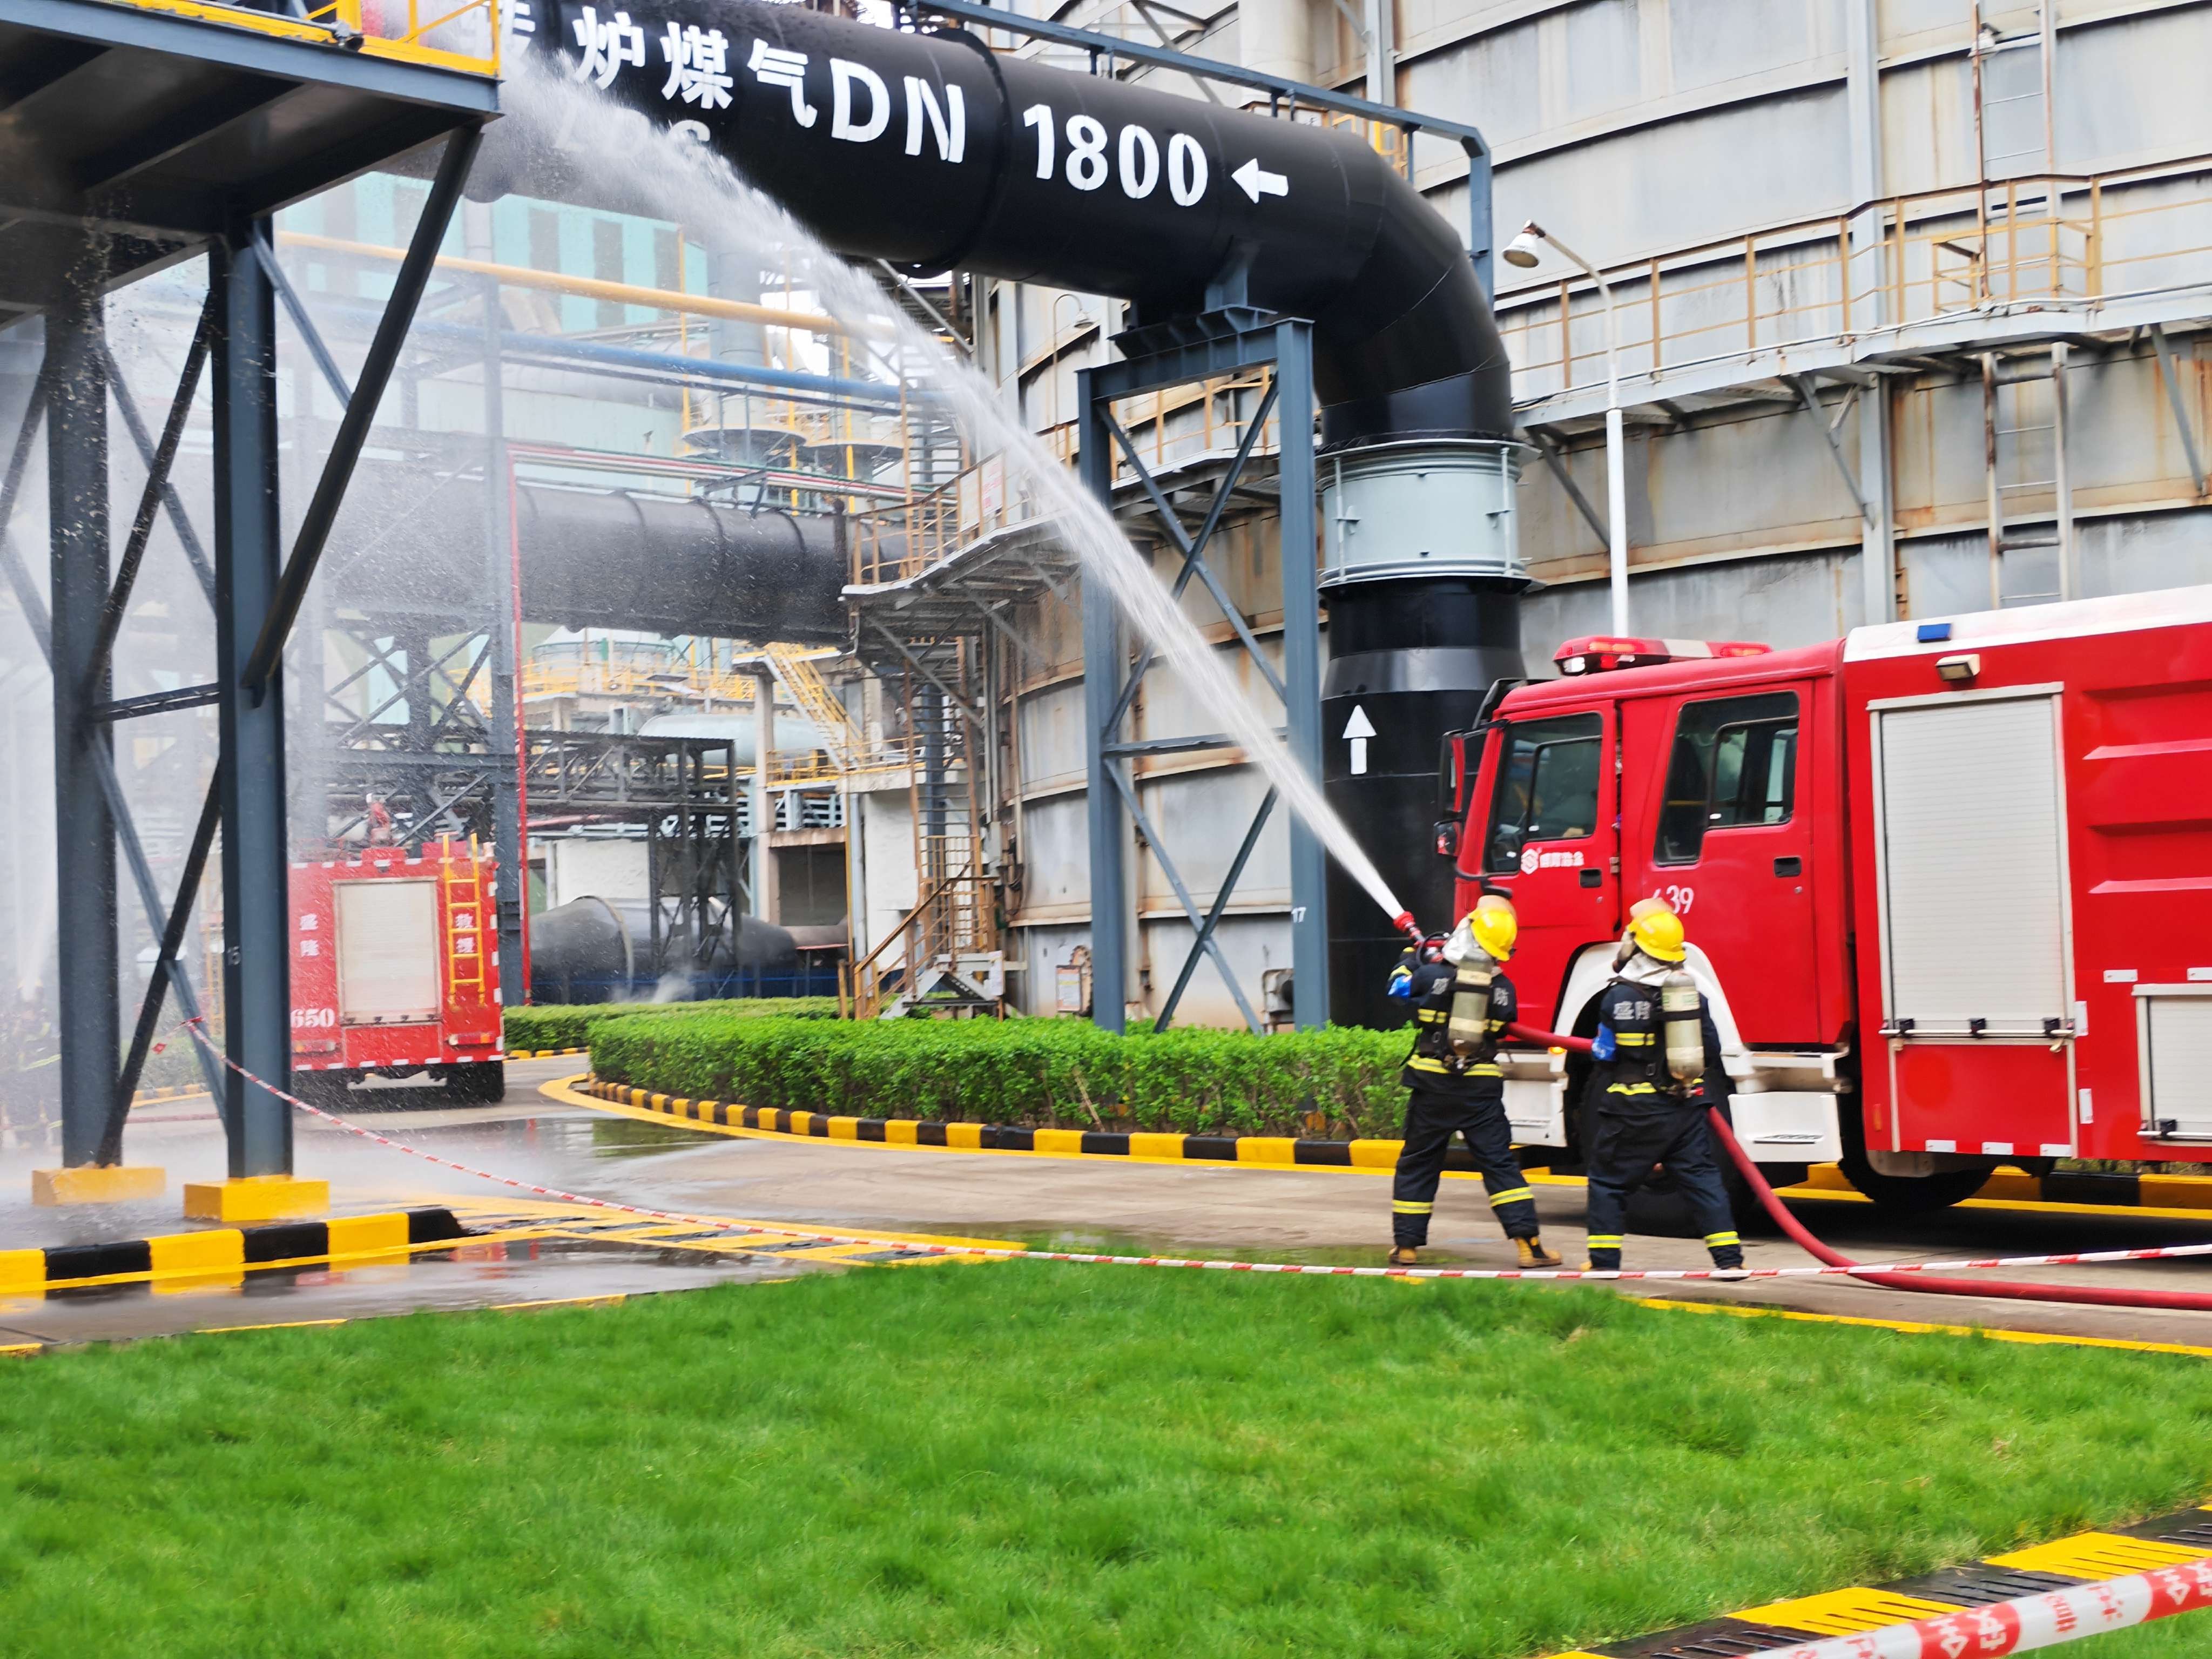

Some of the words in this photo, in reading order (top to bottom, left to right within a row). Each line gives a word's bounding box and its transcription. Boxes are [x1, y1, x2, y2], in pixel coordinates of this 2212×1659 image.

[1023, 104, 1208, 206] 1800
[1653, 885, 1694, 914] 39
[1291, 907, 1306, 923] 17
[291, 1008, 335, 1028] 650
